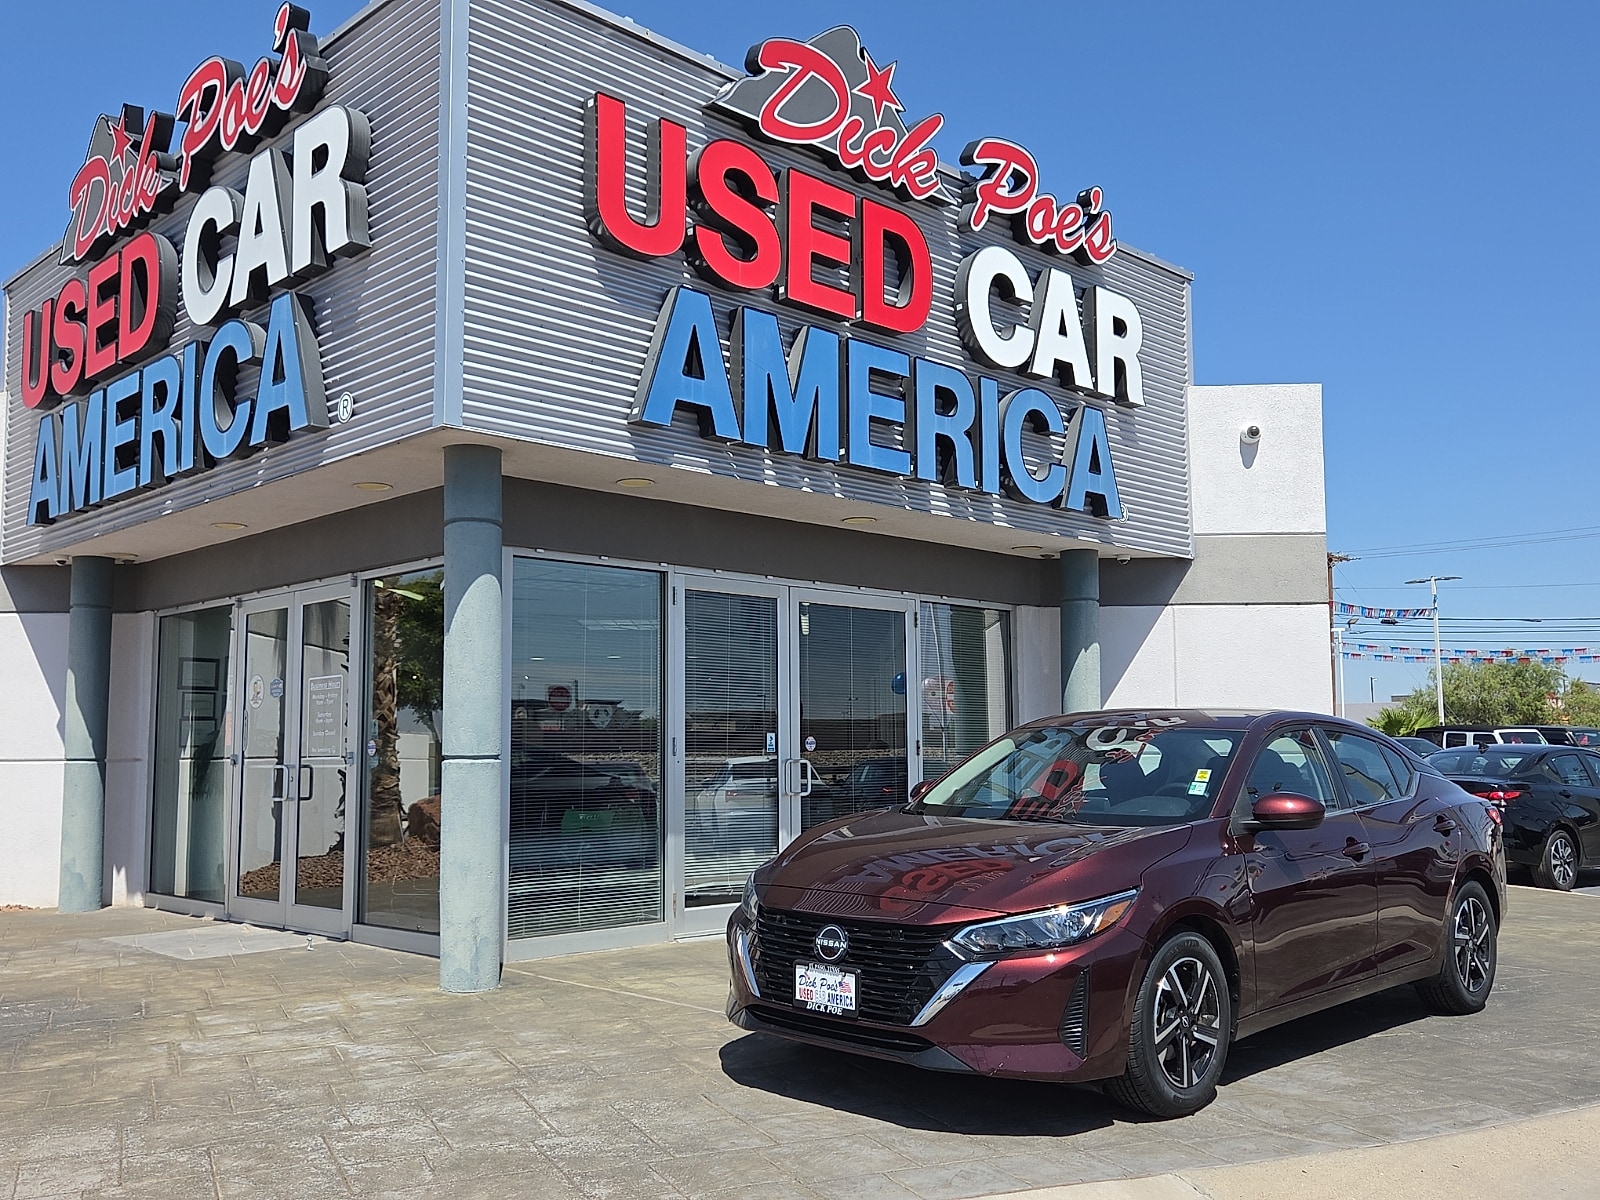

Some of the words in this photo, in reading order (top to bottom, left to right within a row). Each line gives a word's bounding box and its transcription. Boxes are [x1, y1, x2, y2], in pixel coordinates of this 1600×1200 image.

[70, 110, 161, 262] Dick
[177, 2, 308, 192] Poe's
[757, 36, 946, 201] Dick
[968, 137, 1118, 265] Poe's
[21, 231, 162, 410] USED
[182, 104, 354, 326] CAR
[595, 91, 934, 335] USED
[965, 245, 1146, 408] CAR
[26, 291, 310, 527] AMERICA
[640, 286, 1122, 520] AMERICA
[798, 974, 818, 988] Dick
[819, 977, 838, 992] Poe's
[799, 987, 814, 1001] USED
[827, 992, 854, 1009] AMERICA
[806, 1001, 826, 1013] DICK
[826, 1005, 843, 1016] POE
[816, 938, 847, 949] NISSAN
